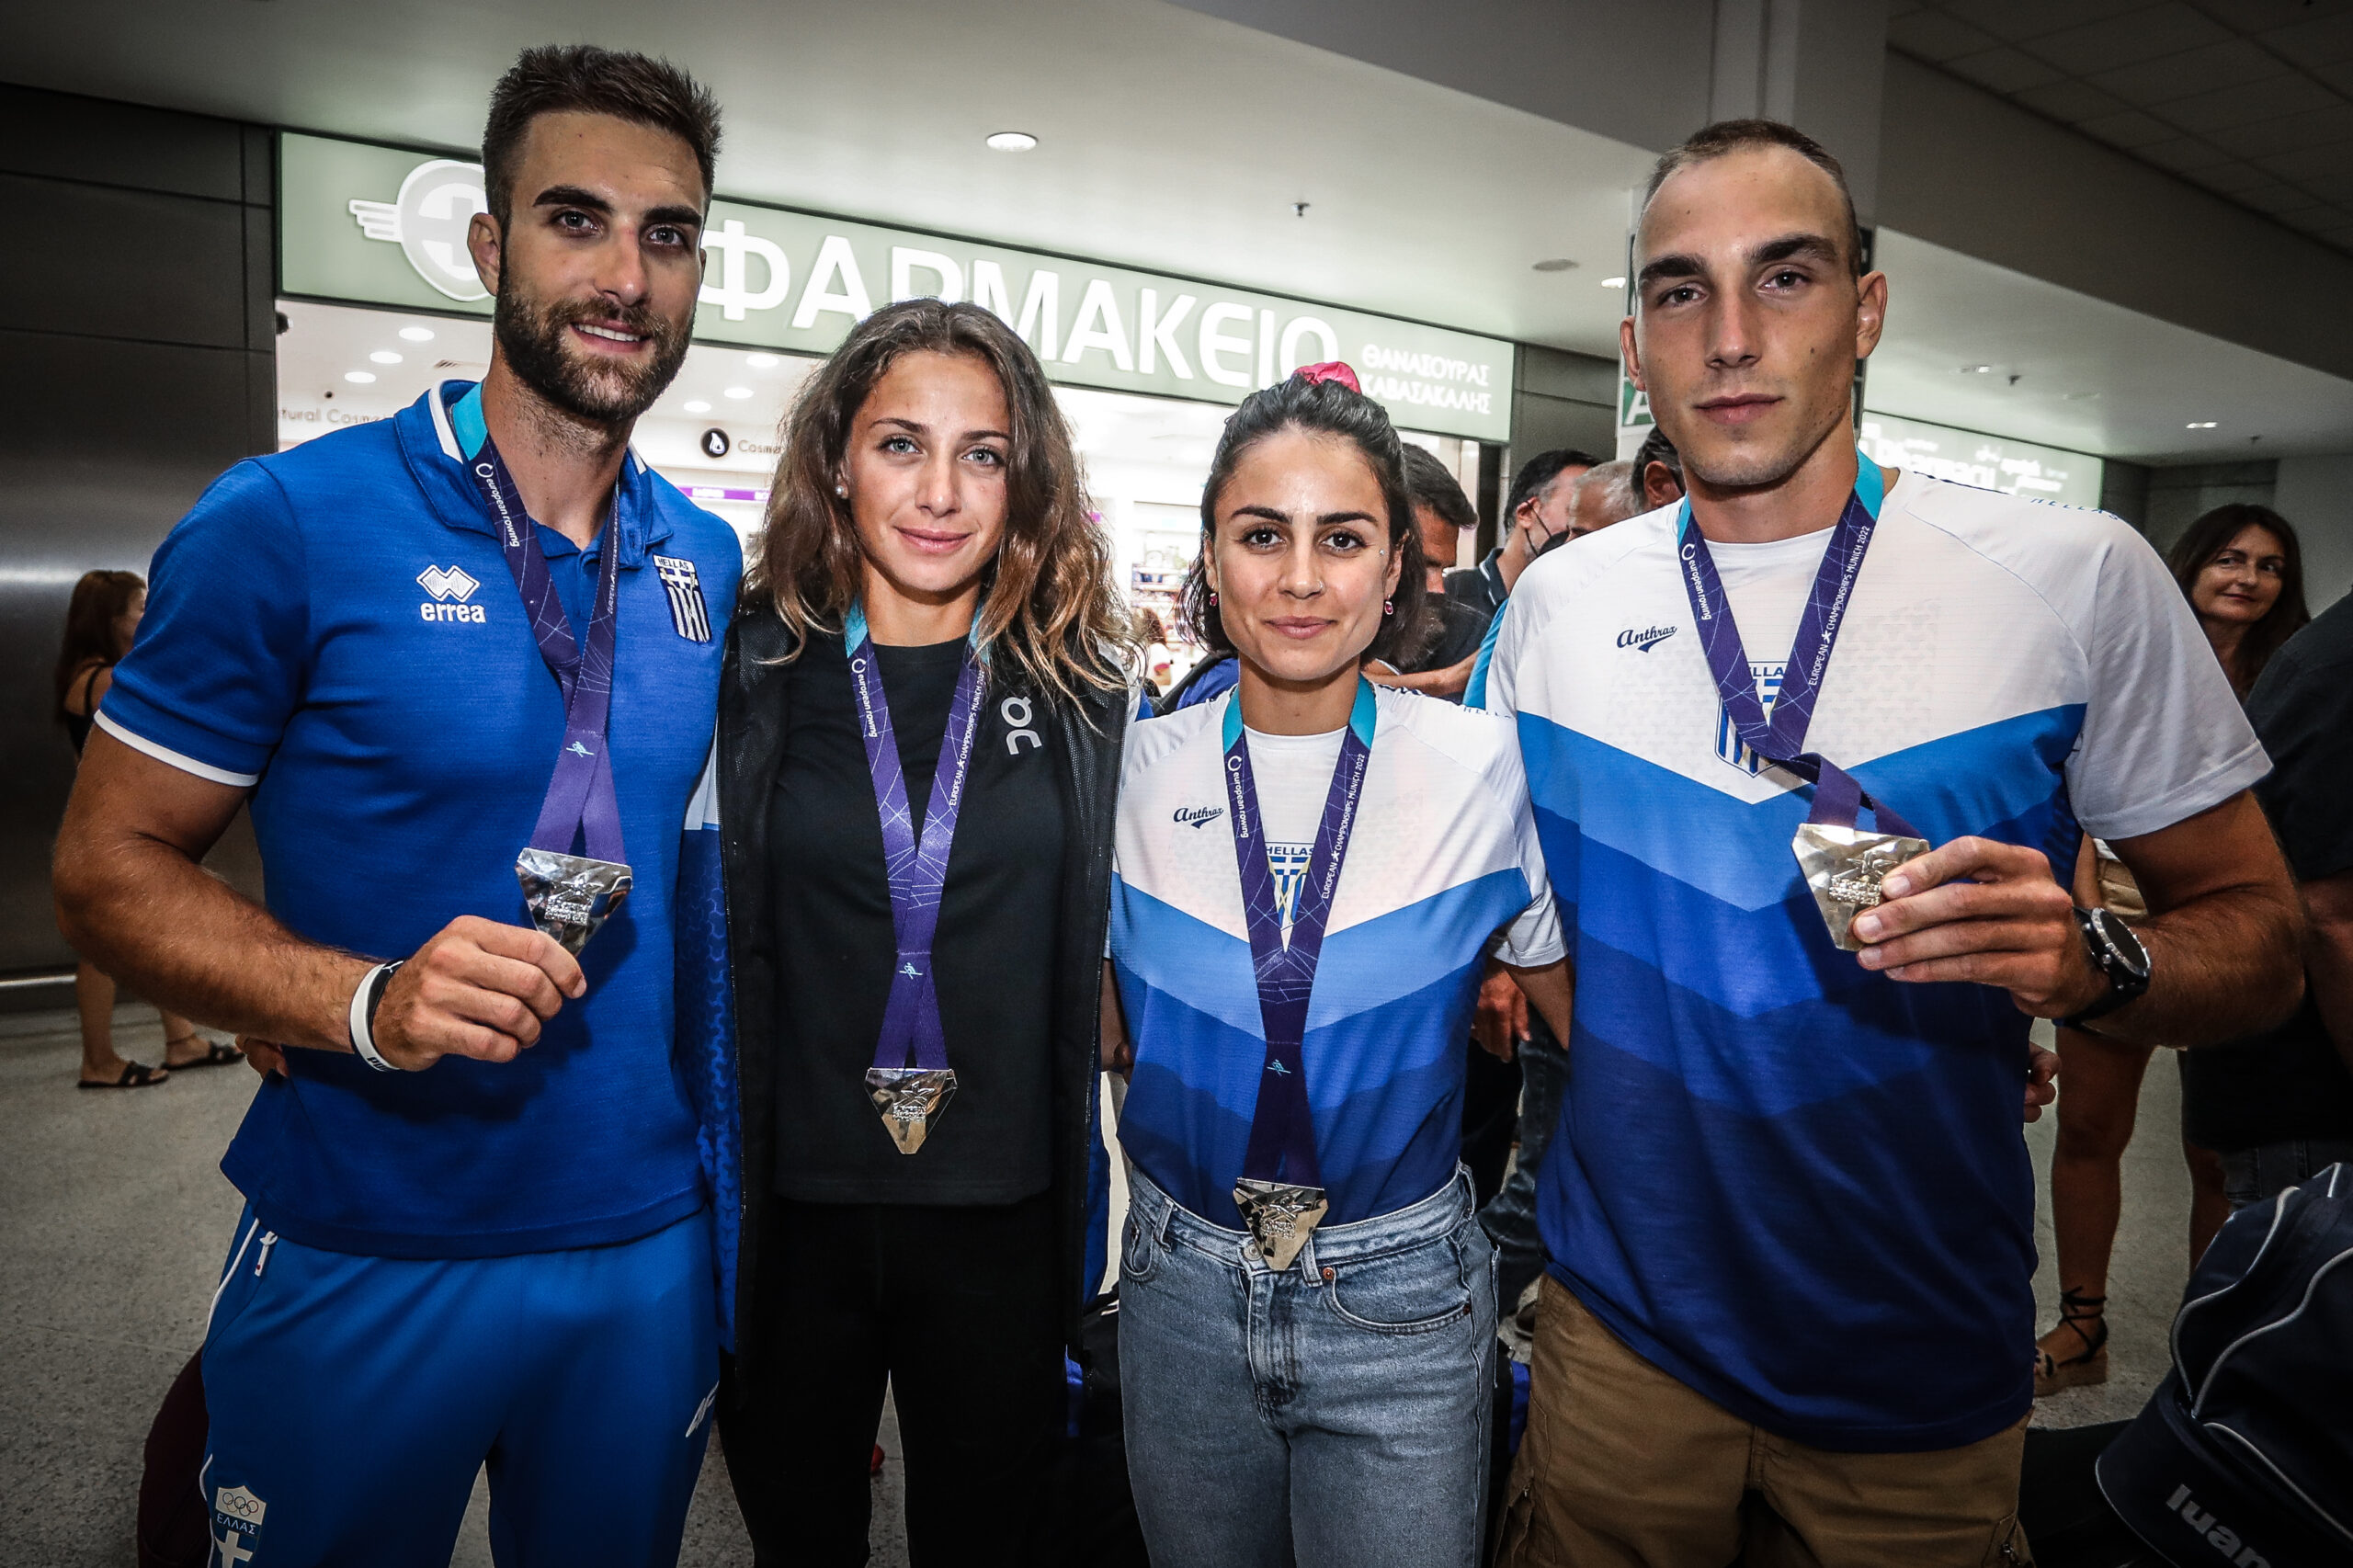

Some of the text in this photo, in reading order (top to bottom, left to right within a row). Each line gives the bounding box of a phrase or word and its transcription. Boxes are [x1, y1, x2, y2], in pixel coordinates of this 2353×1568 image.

[485, 478, 520, 548] european rowing
[658, 557, 690, 571] HELLAS
[420, 602, 487, 624] errea
[1688, 559, 1711, 621] european rowing
[1808, 525, 1870, 686] EUROPEAN CHAMPIONSHIPS MUNICH 2022
[1616, 625, 1678, 653] Anthrax
[858, 674, 879, 738] european rowing
[949, 770, 965, 806] EUROPEAN
[1233, 772, 1249, 838] european rowing
[1173, 806, 1224, 828] Anthrax
[1322, 753, 1366, 899] EUROPEAN CHAMPIONSHIPS MUNICH 2022
[216, 1512, 256, 1535] ΕΛΛΑΣ
